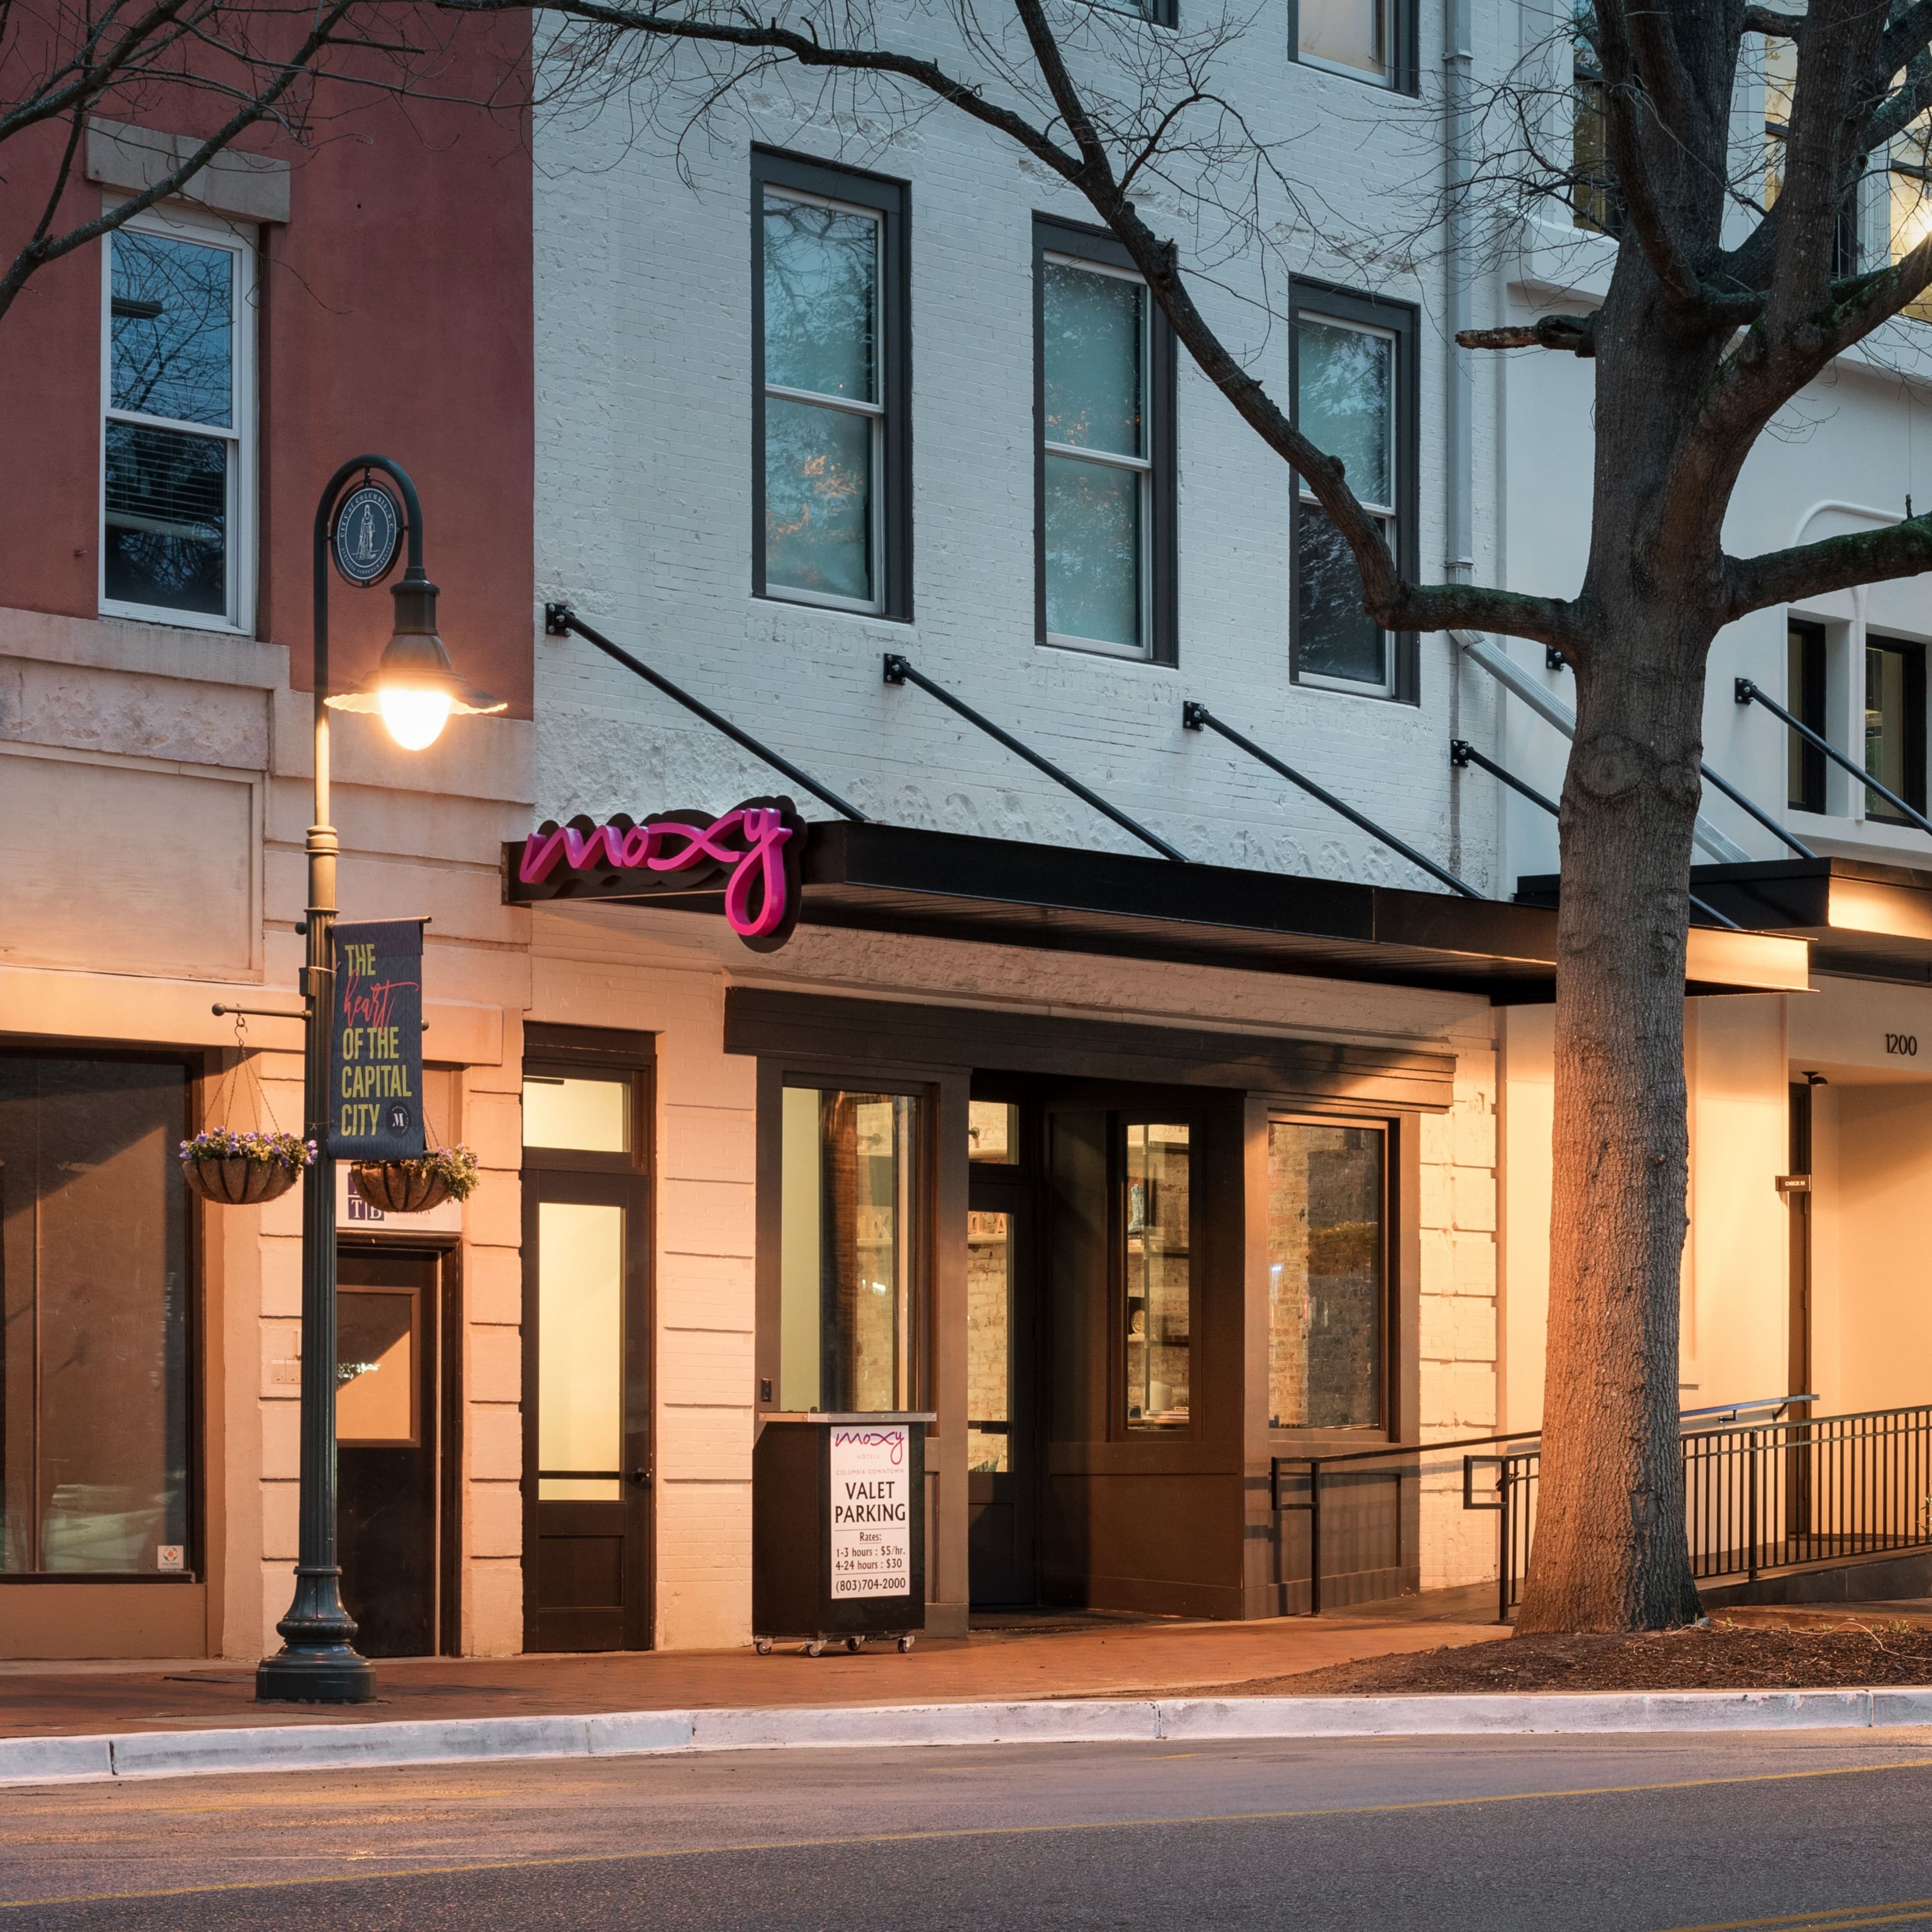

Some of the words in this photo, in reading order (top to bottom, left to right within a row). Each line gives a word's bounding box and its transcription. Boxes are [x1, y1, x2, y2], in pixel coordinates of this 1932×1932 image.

[340, 514, 348, 537] CITY
[348, 503, 355, 512] of
[519, 808, 792, 936] moxy
[345, 944, 376, 977] THE
[343, 969, 419, 1035] heart
[343, 1028, 363, 1060] OF
[368, 1027, 399, 1059] THE
[1886, 1033, 1917, 1056] 1200
[342, 1065, 412, 1098] CAPITAL
[341, 1104, 380, 1136] CITY
[835, 1431, 904, 1465] moxy
[845, 1481, 895, 1500] VALET
[835, 1504, 906, 1523] PARKING
[837, 1548, 849, 1557] 1-3
[852, 1548, 872, 1557] hours
[881, 1546, 906, 1556] $5/hr.
[859, 1532, 881, 1542] Rates:
[836, 1560, 854, 1570] 4-24
[857, 1560, 877, 1570] hours
[887, 1558, 902, 1568] $30
[836, 1578, 906, 1593] (803)704-2000
